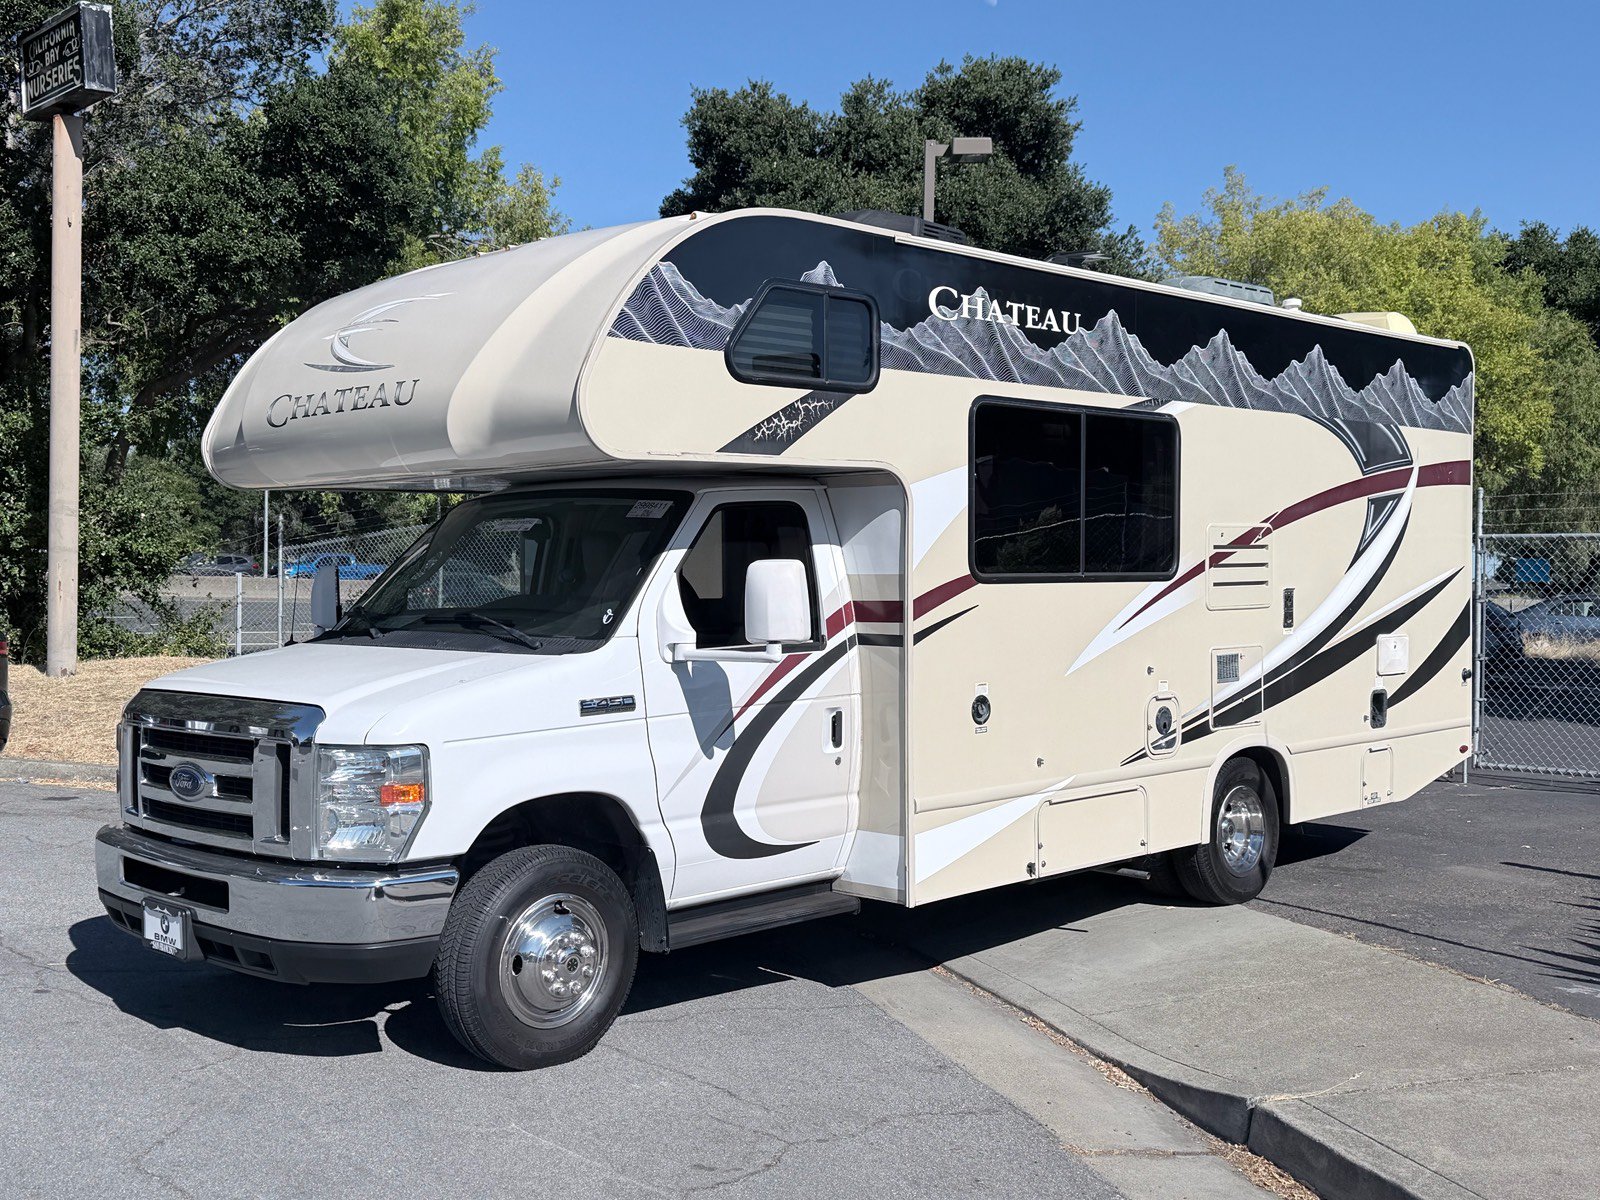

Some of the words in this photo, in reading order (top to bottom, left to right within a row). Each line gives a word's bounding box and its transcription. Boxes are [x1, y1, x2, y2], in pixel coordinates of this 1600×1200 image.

[29, 20, 76, 60] CALIFORNIA
[44, 45, 60, 67] BAY
[27, 55, 82, 107] NURSERIES
[928, 285, 1082, 336] CHATEAU
[266, 378, 421, 428] CHATEAU
[173, 771, 193, 789] Ford
[154, 932, 177, 946] BMW
